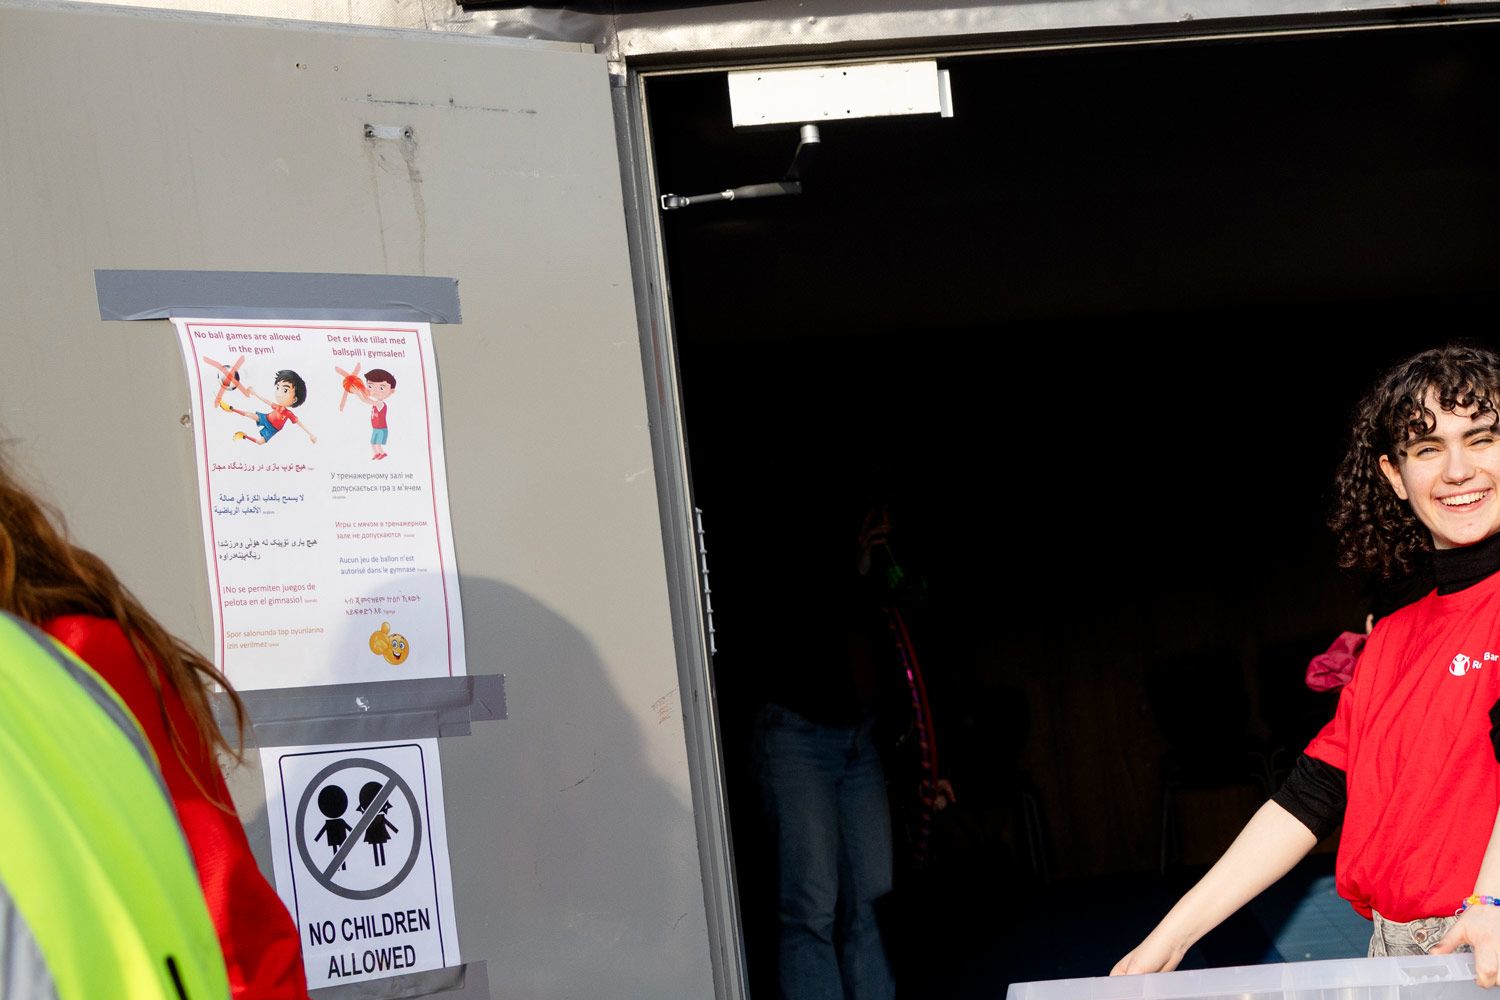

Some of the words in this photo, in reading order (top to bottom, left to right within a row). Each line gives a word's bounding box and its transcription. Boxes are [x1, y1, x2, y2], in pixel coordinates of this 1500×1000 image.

[193, 330, 207, 339] No
[208, 331, 224, 340] ball
[226, 332, 253, 342] games
[254, 333, 267, 341] are
[269, 332, 301, 341] allowed
[326, 334, 342, 343] Det
[352, 335, 369, 344] ikke
[369, 335, 388, 344] tillat
[389, 336, 406, 345] med
[228, 344, 237, 353] in
[239, 344, 253, 353] the
[253, 345, 275, 356] gym!
[332, 346, 362, 357] ballspill
[367, 349, 406, 359] gymsalen!
[329, 472, 336, 480] У
[339, 556, 359, 564] Aucun
[360, 556, 370, 565] jeu
[380, 555, 399, 563] ballon
[366, 566, 382, 574] dans
[389, 566, 416, 575] gymnase
[247, 584, 281, 595] permiten
[281, 583, 305, 594] juegos
[306, 582, 316, 591] de
[224, 598, 248, 608] pelota
[249, 598, 259, 606] en
[259, 597, 267, 606] el
[242, 628, 277, 638] salonunda
[308, 919, 337, 947] NO
[341, 907, 431, 942] CHILDREN
[327, 944, 417, 980] ALLOWED
